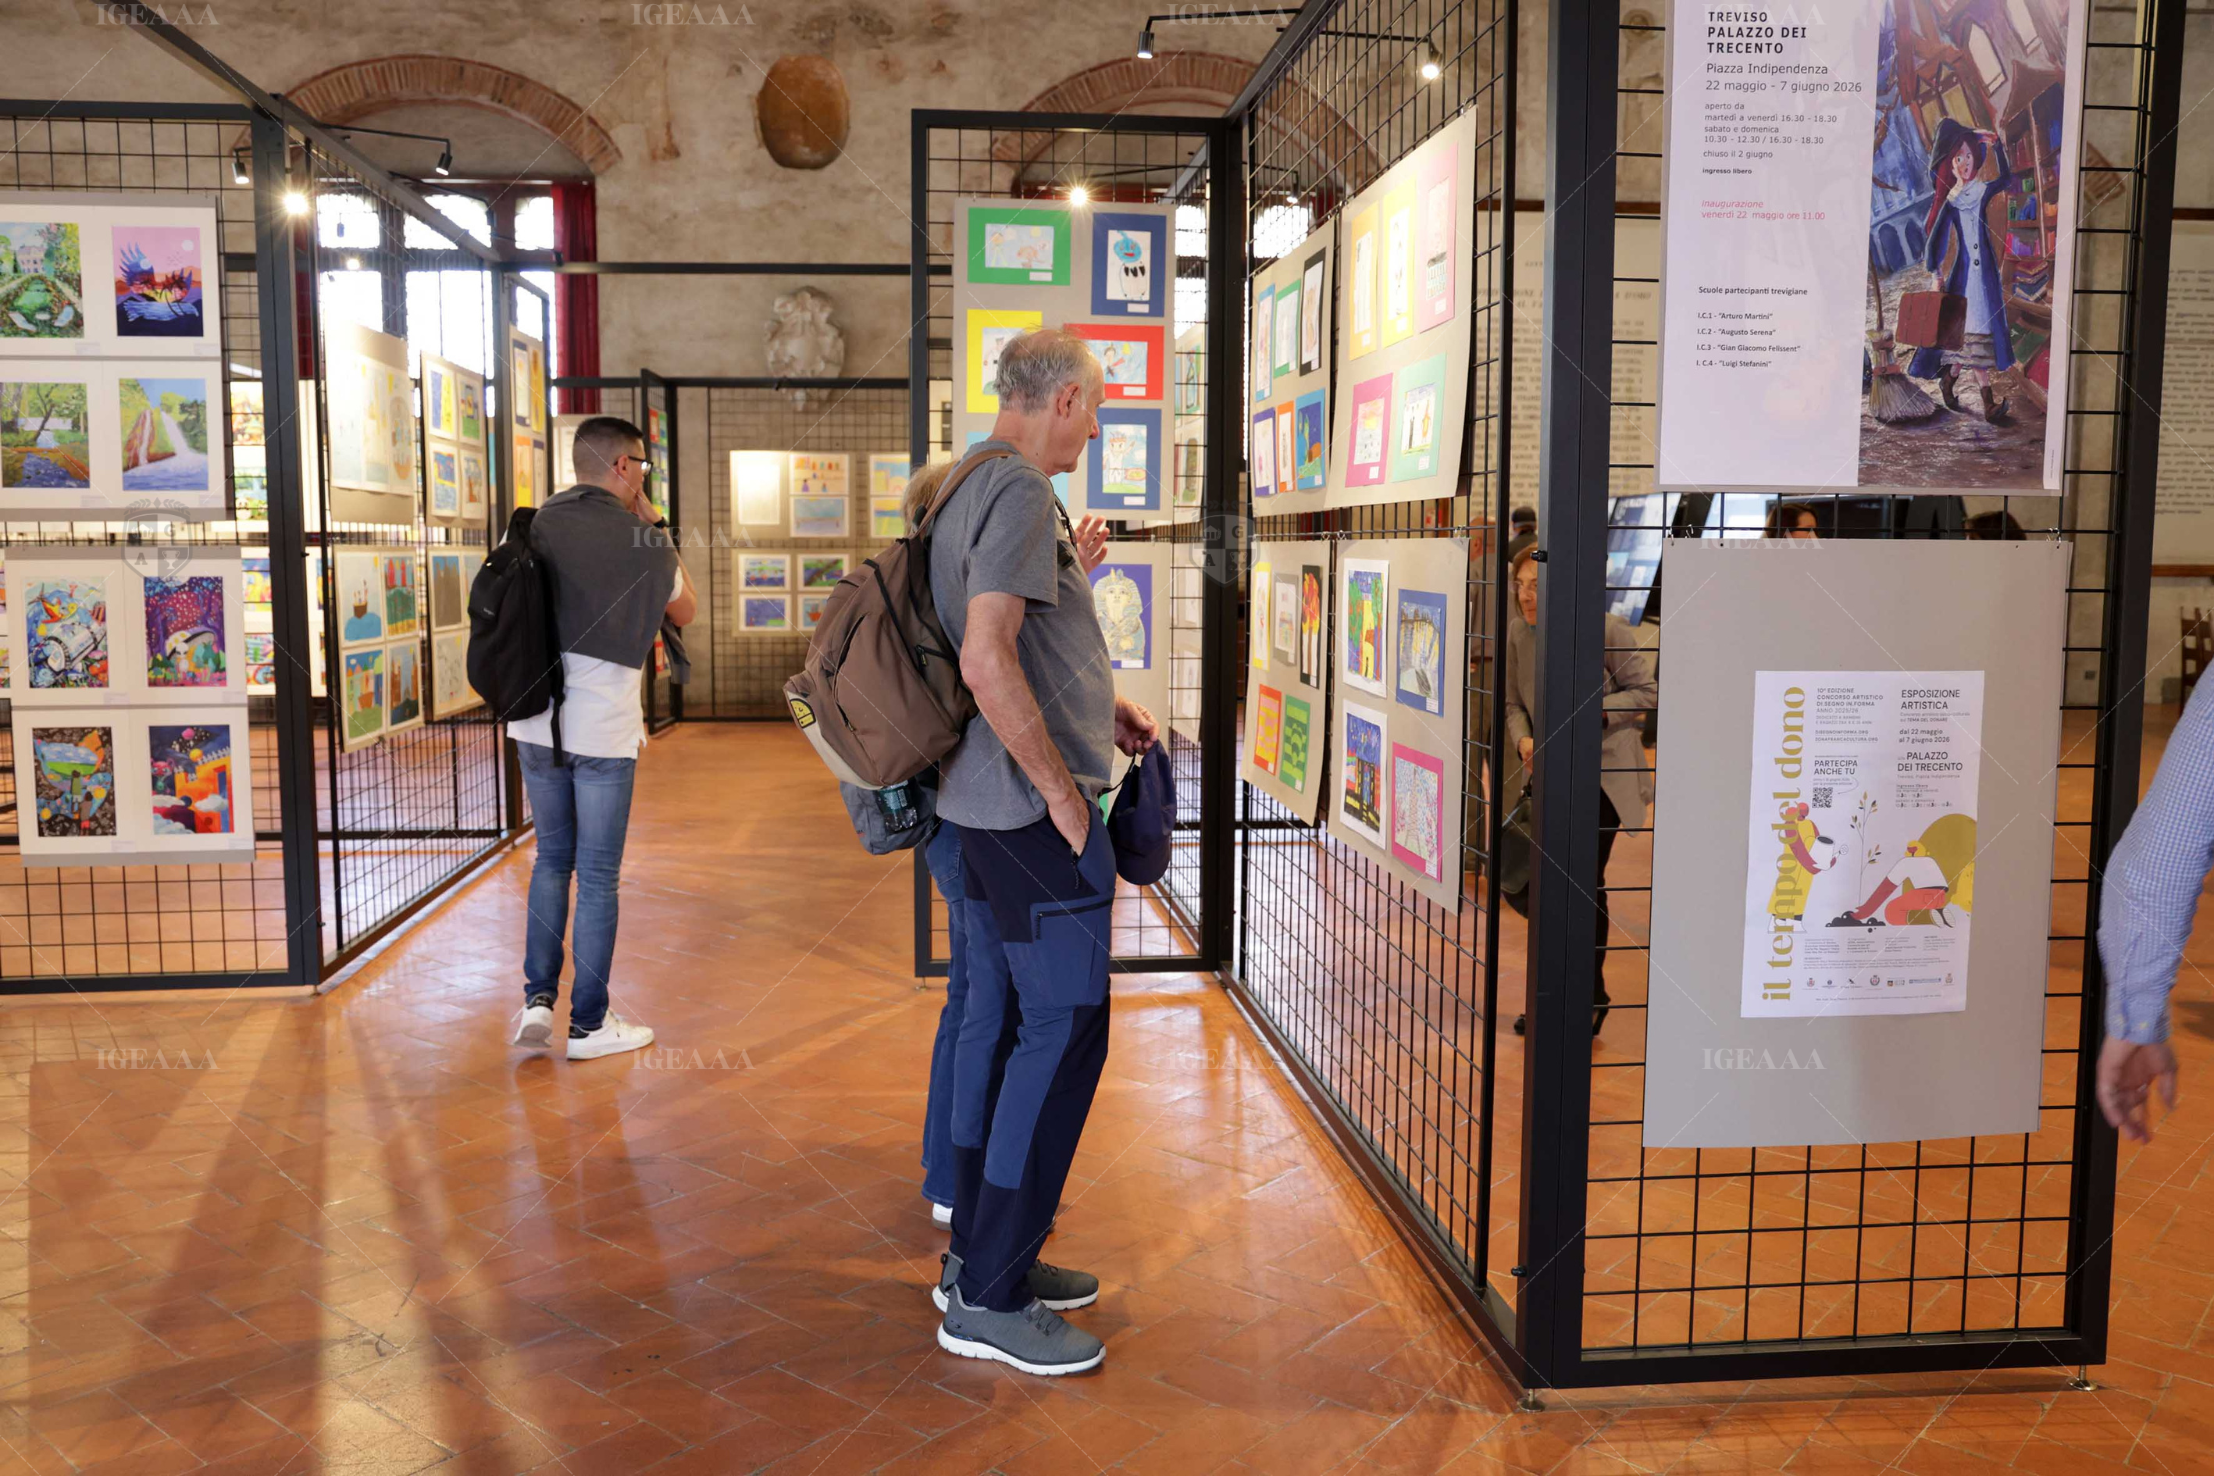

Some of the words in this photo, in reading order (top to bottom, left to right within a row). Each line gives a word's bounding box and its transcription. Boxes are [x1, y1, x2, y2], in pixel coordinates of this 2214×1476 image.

[1708, 12, 1768, 22] TREVISO
[1708, 27, 1774, 38] PALAZZO
[1781, 27, 1807, 38] DEI
[1707, 42, 1784, 54] TRECENTO
[1706, 63, 1744, 74] Piazza
[1748, 63, 1828, 76] Indipendenza
[1705, 80, 1720, 91] 22
[1724, 81, 1767, 93] maggio
[1780, 81, 1787, 91] 7
[1791, 81, 1830, 94] giugno
[1833, 81, 1862, 92] 2026
[1704, 102, 1732, 111] aperto
[1734, 102, 1745, 110] da
[1704, 125, 1731, 133] sabato
[1741, 125, 1779, 133] domenica
[1704, 135, 1728, 143] 10.30
[1737, 136, 1760, 144] 12.30
[1762, 136, 1767, 144] /
[1769, 136, 1792, 144] 16.30
[1801, 137, 1824, 145] 18.30
[1703, 150, 1729, 158] chiuso
[1731, 150, 1736, 158] il
[1738, 150, 1744, 158] 2
[1746, 150, 1773, 160] giugno
[1702, 167, 1731, 175] ingresso
[1733, 167, 1752, 175] libero
[1701, 199, 1764, 209] inaugurazione
[1736, 211, 1748, 219] 22
[1752, 211, 1784, 221] maggio
[1802, 212, 1826, 220] 11.00
[1698, 286, 1724, 294] Scuole
[1724, 287, 1769, 295] partecipanti
[1771, 288, 1808, 296] trevigiane
[1737, 344, 1767, 352] Giacomo
[1901, 689, 1961, 698] ESPOSIZIONE
[1900, 701, 1949, 710] ARTISTICA
[1774, 687, 1805, 779] dono
[1920, 728, 1943, 736] maggio
[1906, 751, 1948, 760] PALAZZO
[1897, 763, 1913, 772] DEI
[1915, 762, 1964, 772] TRECENTO
[1771, 787, 1801, 845] del
[1767, 853, 1803, 969] tempo
[1762, 978, 1791, 1001] il
